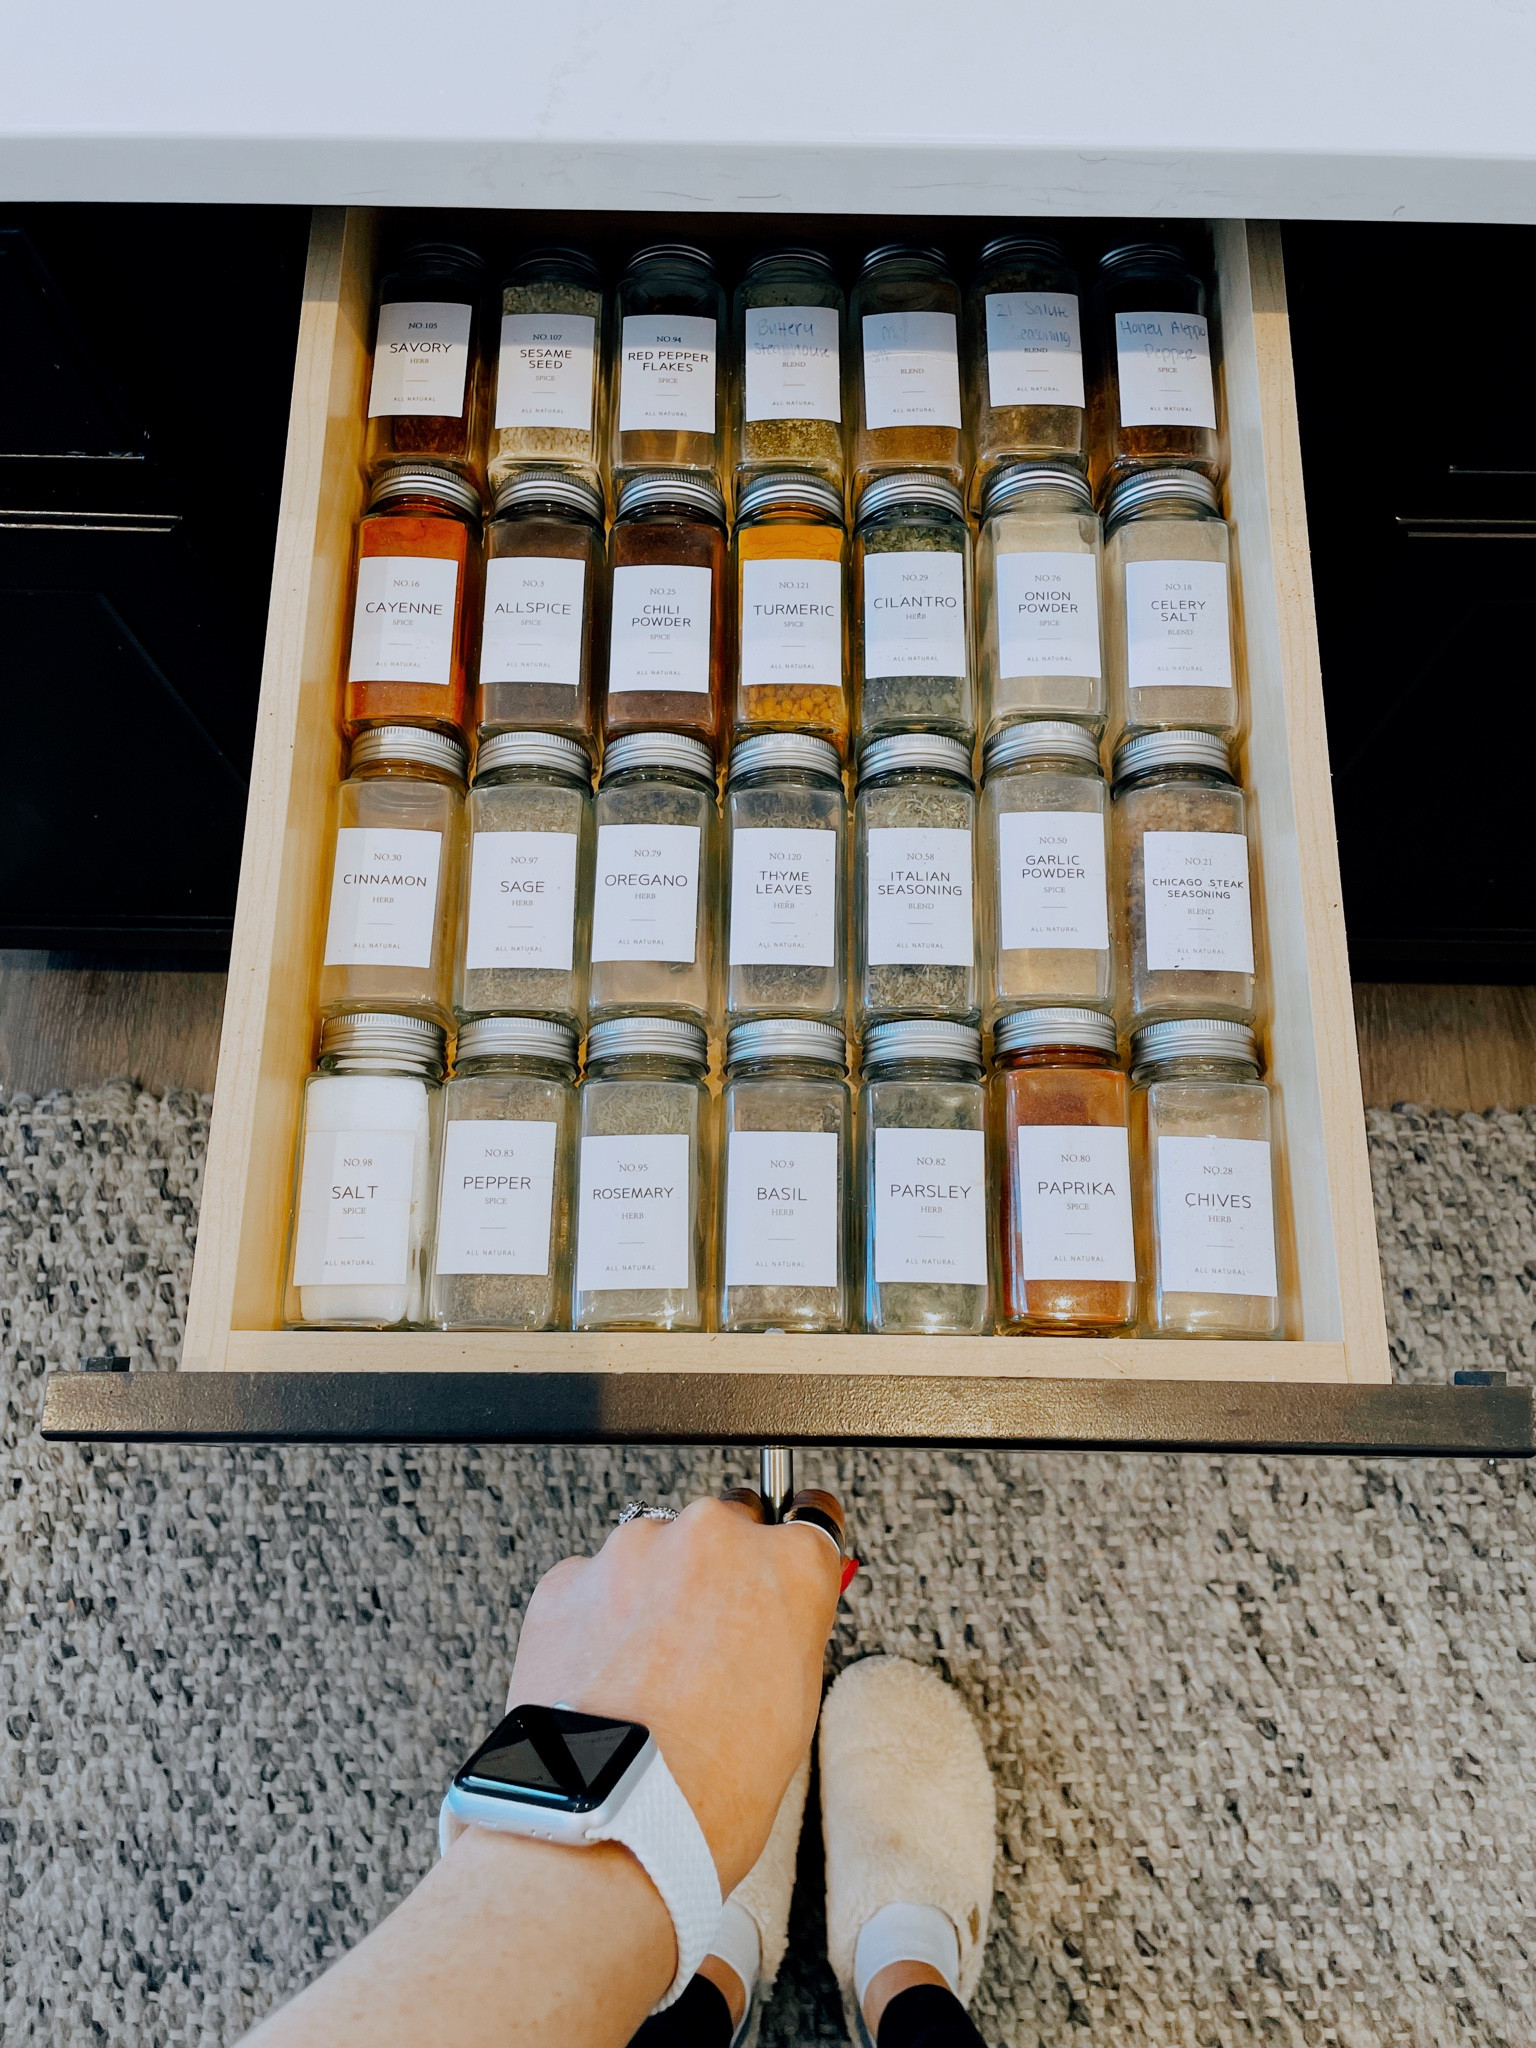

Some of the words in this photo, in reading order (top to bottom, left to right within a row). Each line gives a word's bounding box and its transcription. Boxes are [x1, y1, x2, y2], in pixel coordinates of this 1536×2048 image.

[1120, 320, 1163, 337] Honey
[391, 343, 452, 353] SAVORY
[521, 349, 571, 359] SESAME
[628, 352, 653, 360] RED
[659, 352, 708, 364] PEPPER
[529, 360, 562, 368] SEED
[643, 362, 694, 372] FLAKES
[657, 410, 688, 418] NATURAL
[902, 575, 928, 583] NO.29
[1035, 575, 1061, 583] NO.76
[1025, 592, 1070, 601] ONION
[874, 597, 956, 608] CILANTRO
[1151, 601, 1205, 609] CELERY
[366, 602, 442, 615] CAYENNE
[495, 603, 571, 615] ALLSPICE
[644, 605, 679, 614] CHILI
[754, 604, 834, 616] TURMERIC
[1019, 604, 1078, 613] POWDER
[632, 617, 690, 626] POWDER
[1161, 613, 1197, 621] SALT
[520, 661, 552, 669] NATURAL
[374, 853, 401, 861] NO.30
[1026, 855, 1079, 865] GARLIC
[760, 871, 808, 881] THYME
[891, 872, 949, 881] ITALIAN
[1023, 868, 1085, 878] POWDER
[344, 874, 426, 886] CINNAMON
[605, 874, 687, 886] OREGANO
[1208, 880, 1243, 889] STEAK
[501, 881, 544, 892] SAGE
[756, 884, 811, 895] LEAVES
[878, 885, 962, 895] SEASONING
[1168, 889, 1230, 899] SEASONING
[774, 901, 795, 909] HERB
[1188, 908, 1214, 916] BLEND
[1046, 925, 1079, 933] NATURAL
[368, 942, 401, 950] NATURAL
[510, 945, 543, 954] NATURAL
[758, 941, 772, 950] ALL
[773, 941, 806, 949] NATURAL
[1192, 947, 1225, 955] NATURAL
[485, 1149, 513, 1157] NO.83
[917, 1157, 945, 1165] NO.82
[1061, 1154, 1090, 1162] NO.80
[619, 1163, 648, 1172] NO.95
[771, 1160, 794, 1168] NO.9
[1203, 1166, 1233, 1175] NO.28
[464, 1177, 531, 1189] PEPPER
[332, 1186, 378, 1199] SALT
[891, 1185, 971, 1198] PARSLEY
[1038, 1182, 1115, 1195] PAPRIKA
[593, 1188, 673, 1199] ROSEMARY
[758, 1188, 807, 1200] BASIL
[1185, 1193, 1251, 1208] CHIVES
[482, 1249, 516, 1257] NATURAL
[324, 1259, 337, 1267] ALL
[340, 1258, 375, 1266] NATURAL
[905, 1257, 918, 1265] ALL
[921, 1258, 956, 1266] NATURAL
[1070, 1255, 1105, 1263] NATURAL
[755, 1260, 768, 1268] ALL
[771, 1260, 805, 1268] NATURAL
[1211, 1267, 1247, 1276] NATURAL
